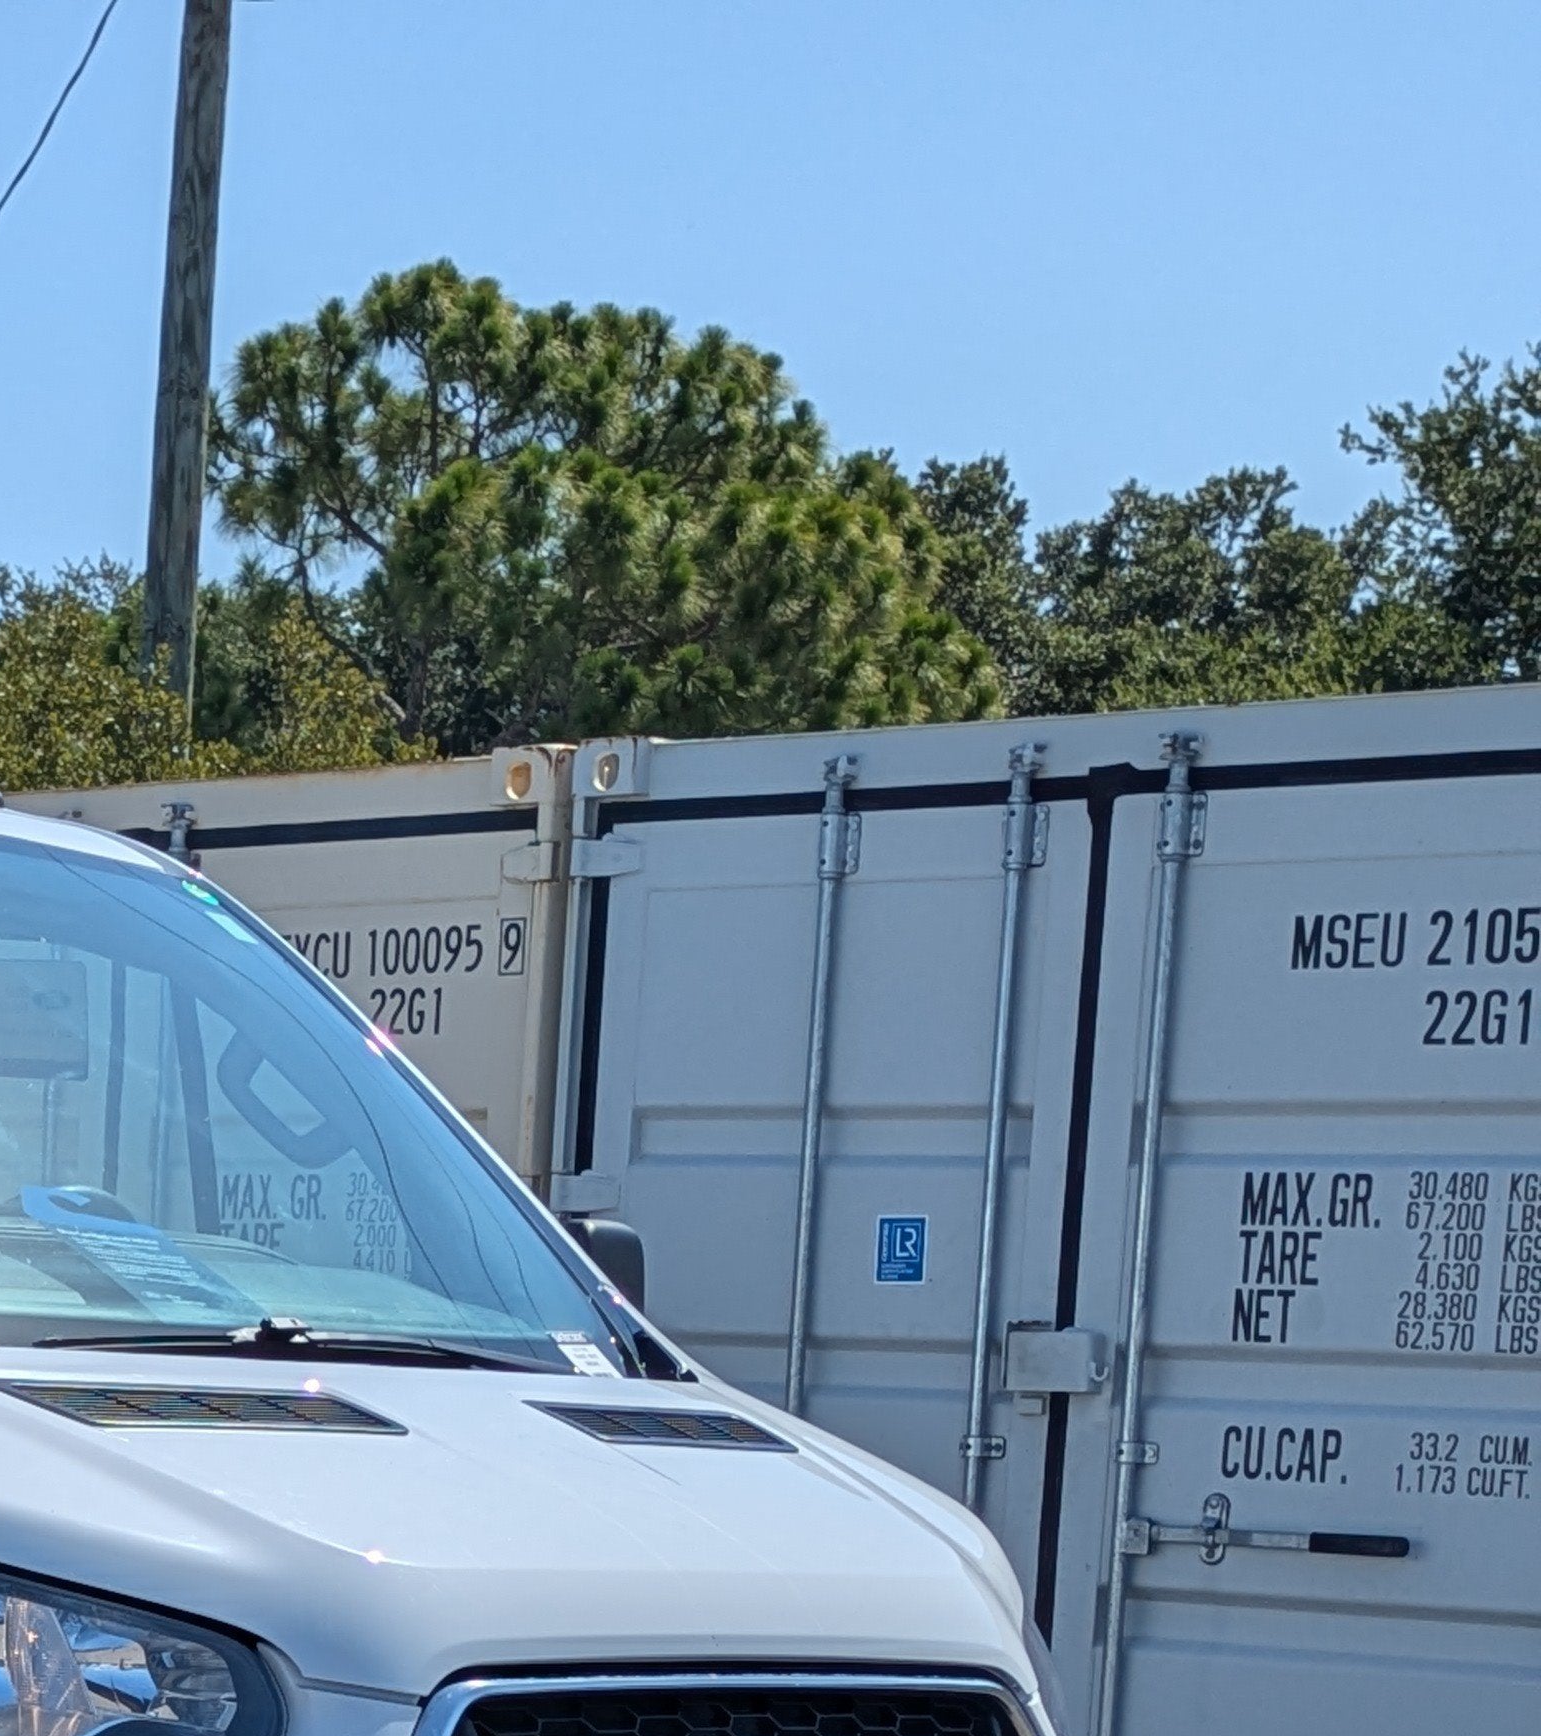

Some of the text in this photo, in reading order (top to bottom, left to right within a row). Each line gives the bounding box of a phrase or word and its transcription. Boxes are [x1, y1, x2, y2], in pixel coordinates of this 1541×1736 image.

[281, 921, 523, 979] YCU 100095 9
[1291, 906, 1541, 970] MSEU 2105
[369, 987, 443, 1035] 22G1
[1422, 988, 1533, 1045] 22G1
[1239, 1171, 1381, 1229] MAX.GR.
[1408, 1170, 1541, 1203] 30.480 KG
[1405, 1201, 1486, 1231] 67.200
[895, 1227, 917, 1258] LR
[1239, 1230, 1323, 1286] TARE
[1417, 1231, 1484, 1261] 2.100
[1415, 1261, 1541, 1294] 4.630 LBS
[1231, 1288, 1296, 1344] NET
[1396, 1290, 1541, 1325] 28.380 KGS
[1395, 1320, 1539, 1355] 62.570 LBS
[1220, 1425, 1348, 1485] CU.CAP.
[1409, 1431, 1459, 1463] 33.2
[1395, 1463, 1457, 1495] 1.173
